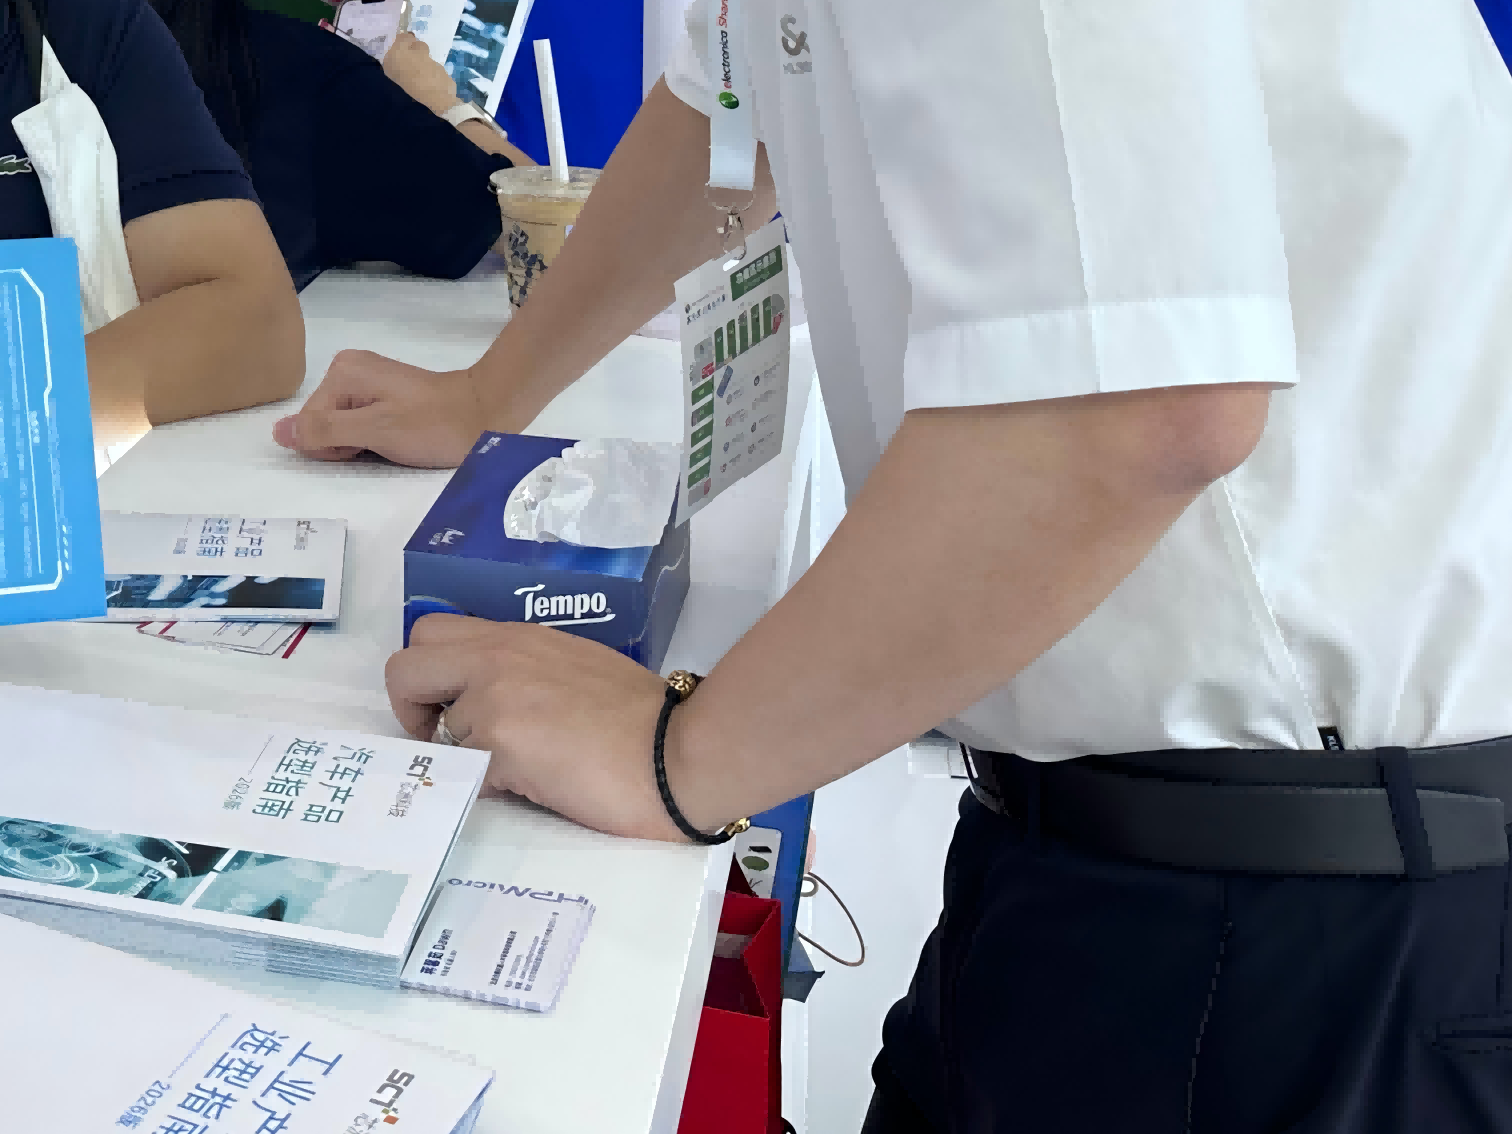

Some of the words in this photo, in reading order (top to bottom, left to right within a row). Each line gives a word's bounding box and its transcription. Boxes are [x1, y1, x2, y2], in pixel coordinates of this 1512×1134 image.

[513, 583, 608, 622] Tempo
[251, 737, 329, 820] 选型指南
[300, 743, 377, 824] 汽车产品
